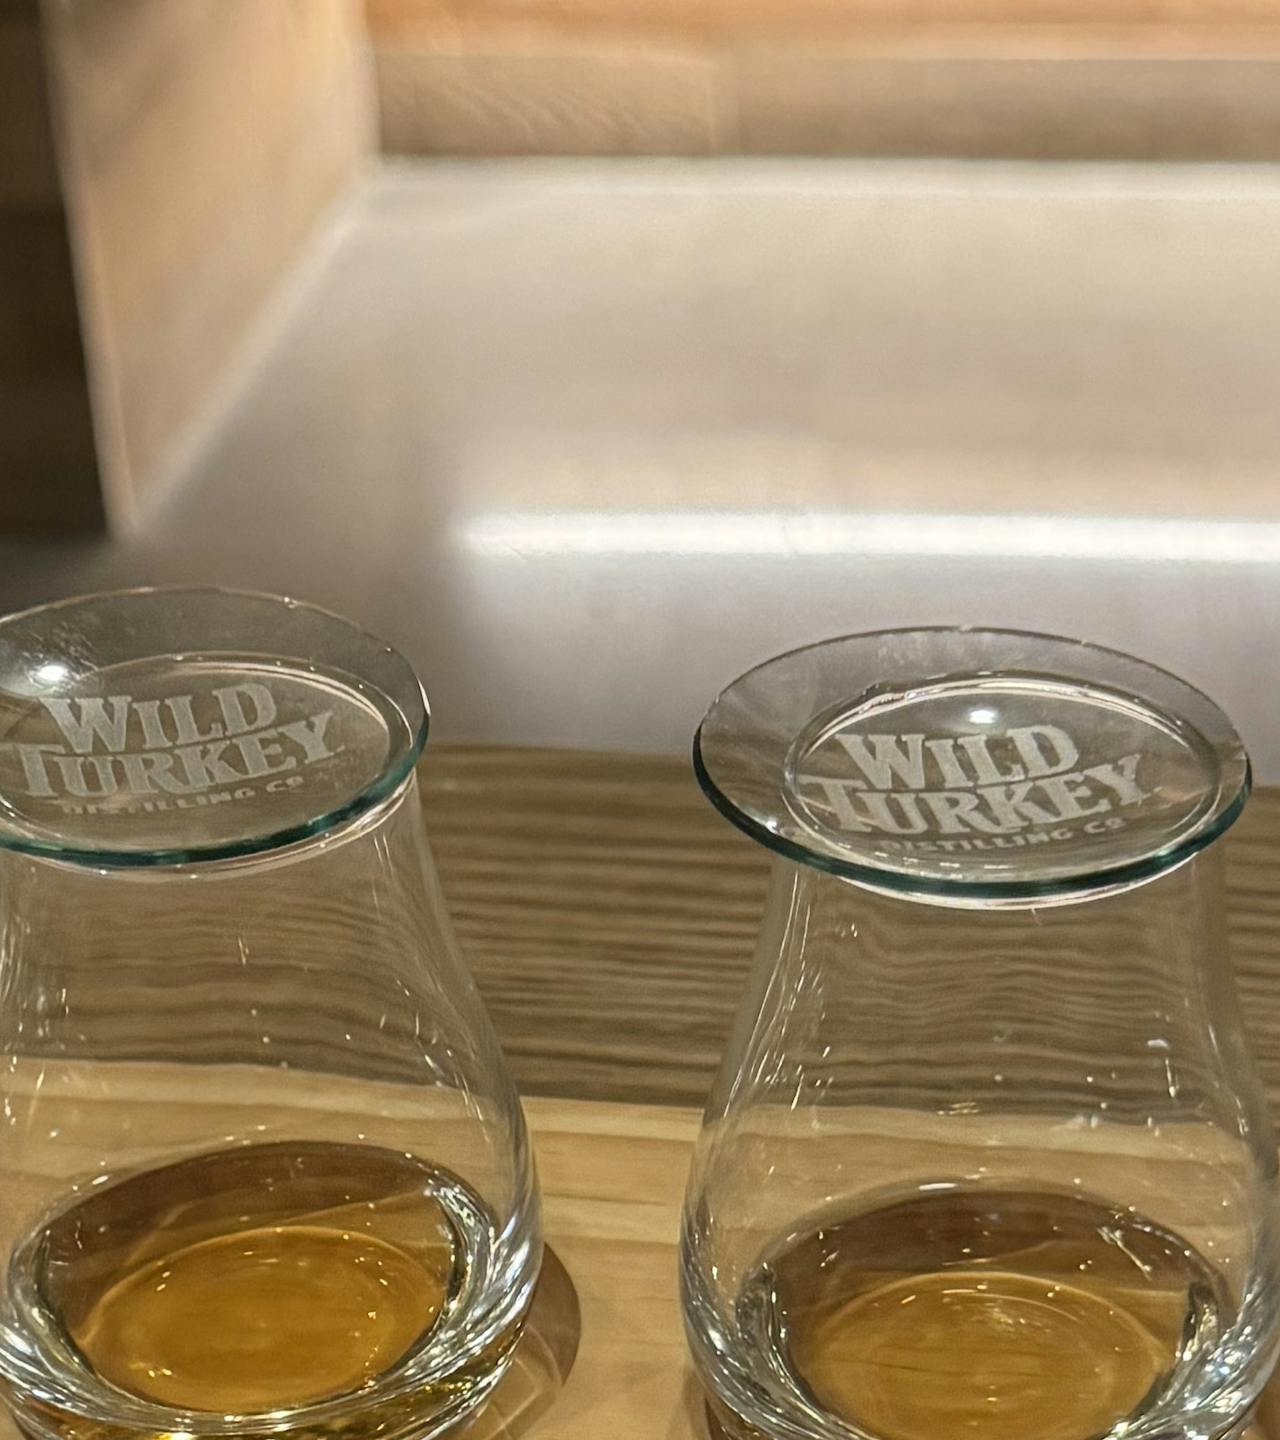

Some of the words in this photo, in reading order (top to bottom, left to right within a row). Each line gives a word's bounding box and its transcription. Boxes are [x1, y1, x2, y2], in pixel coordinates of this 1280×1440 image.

[38, 683, 278, 754] WILD
[835, 724, 1080, 790] WILD
[797, 753, 1158, 835] TURKEY
